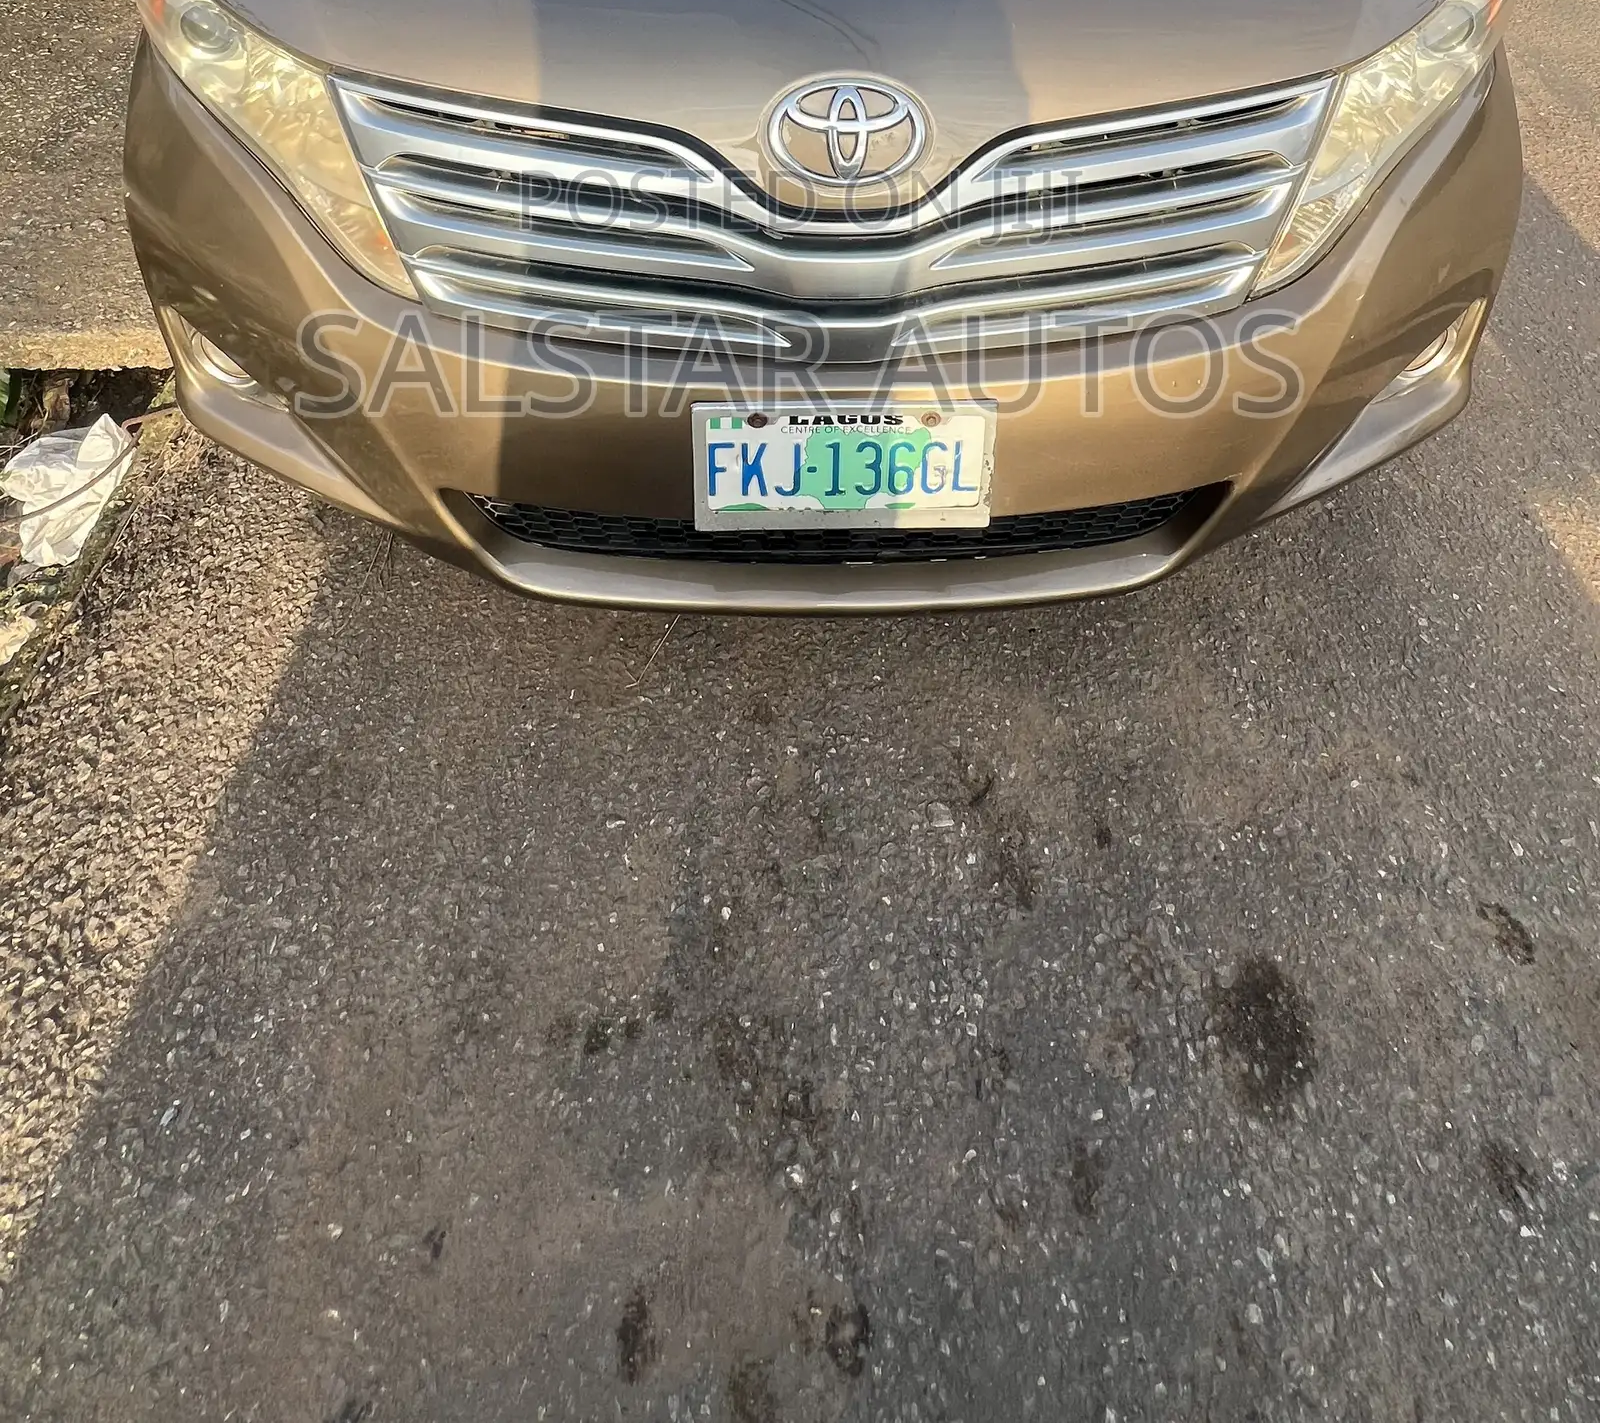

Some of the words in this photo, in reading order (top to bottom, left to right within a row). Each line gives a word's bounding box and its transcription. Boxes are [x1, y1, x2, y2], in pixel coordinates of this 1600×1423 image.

[788, 415, 904, 426] LAGOS
[780, 426, 821, 434] CENTRE
[824, 426, 841, 434] OF
[842, 426, 912, 435] EXCELLENCE
[708, 440, 978, 497] FKJ-136GL
